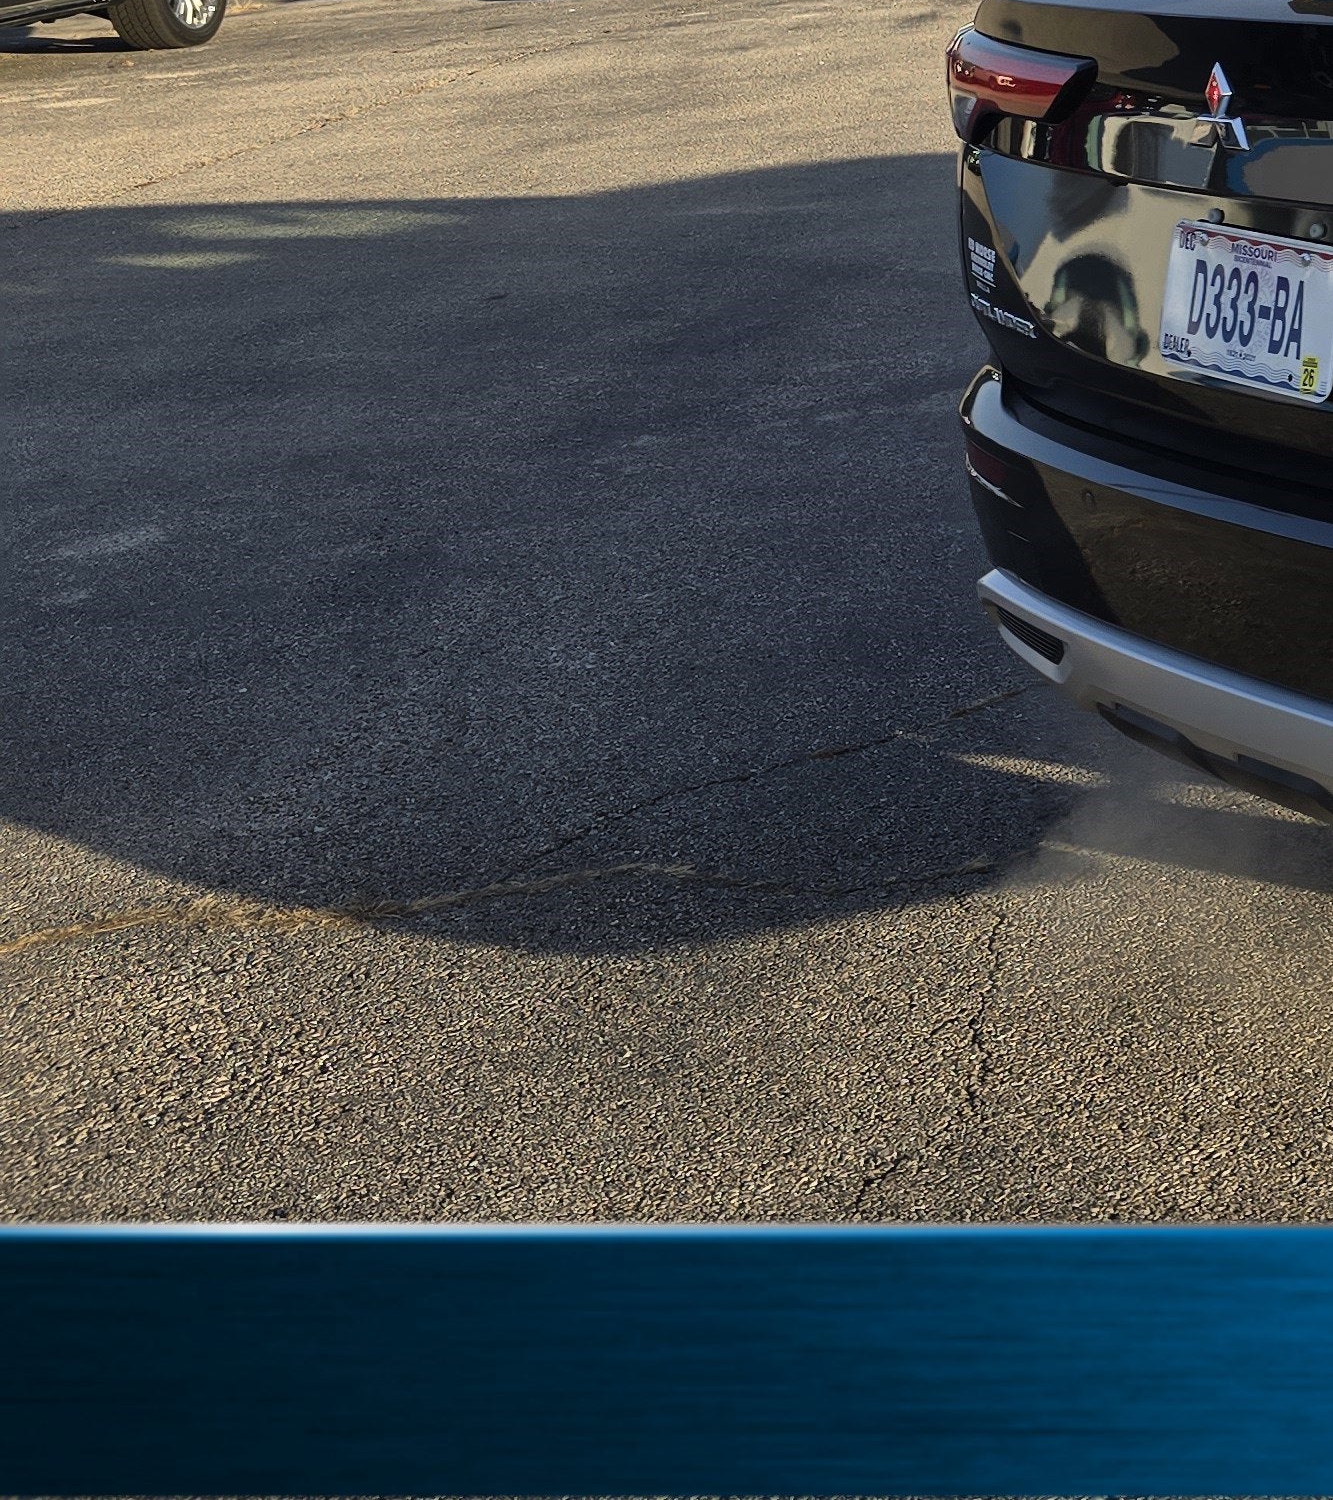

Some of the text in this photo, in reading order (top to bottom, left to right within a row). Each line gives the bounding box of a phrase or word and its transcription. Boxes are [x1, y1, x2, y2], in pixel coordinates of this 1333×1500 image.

[1178, 230, 1197, 251] DEC
[1230, 242, 1279, 263] MISSOURI
[1186, 258, 1305, 361] D333-BA
[1163, 332, 1190, 355] DEALER
[1302, 367, 1315, 388] 26
